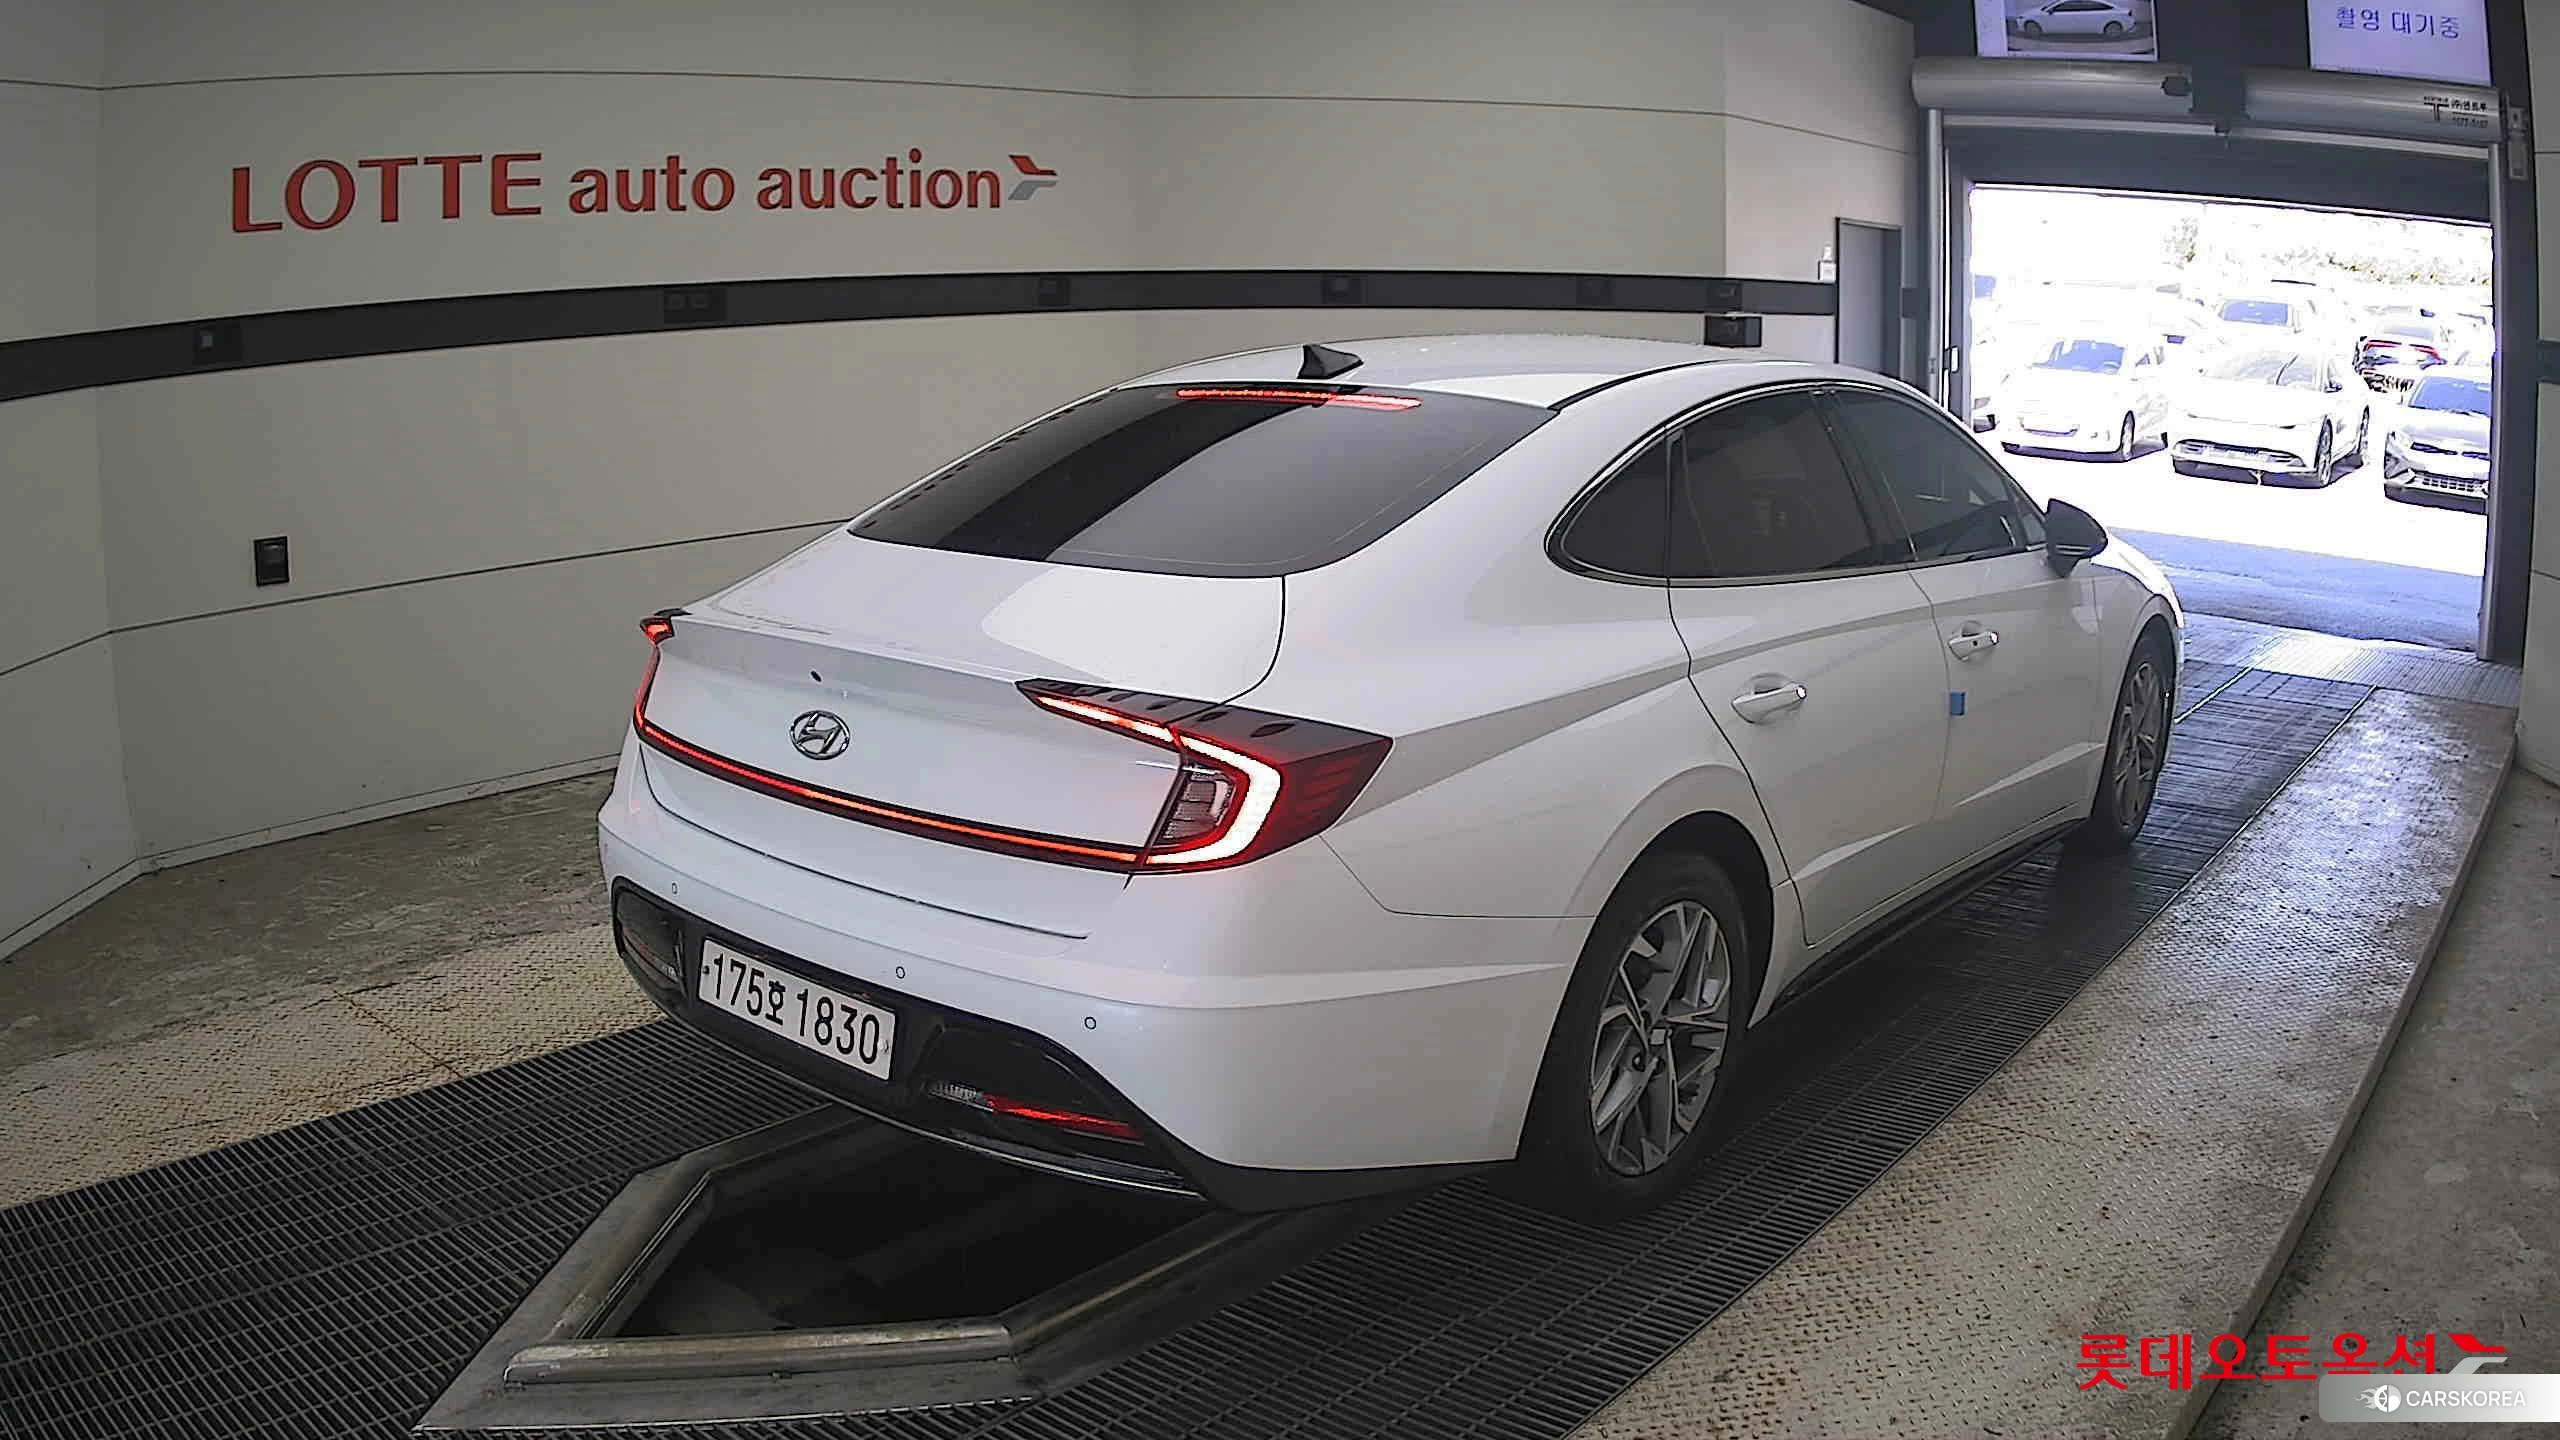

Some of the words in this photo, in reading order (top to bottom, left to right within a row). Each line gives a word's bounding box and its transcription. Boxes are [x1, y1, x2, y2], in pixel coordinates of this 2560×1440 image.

[2391, 11, 2460, 39] 대기중
[232, 152, 542, 233] LOTTE
[568, 154, 736, 214] auto
[757, 147, 1001, 210] auction
[713, 953, 786, 1026] 175호
[796, 988, 880, 1065] 1830
